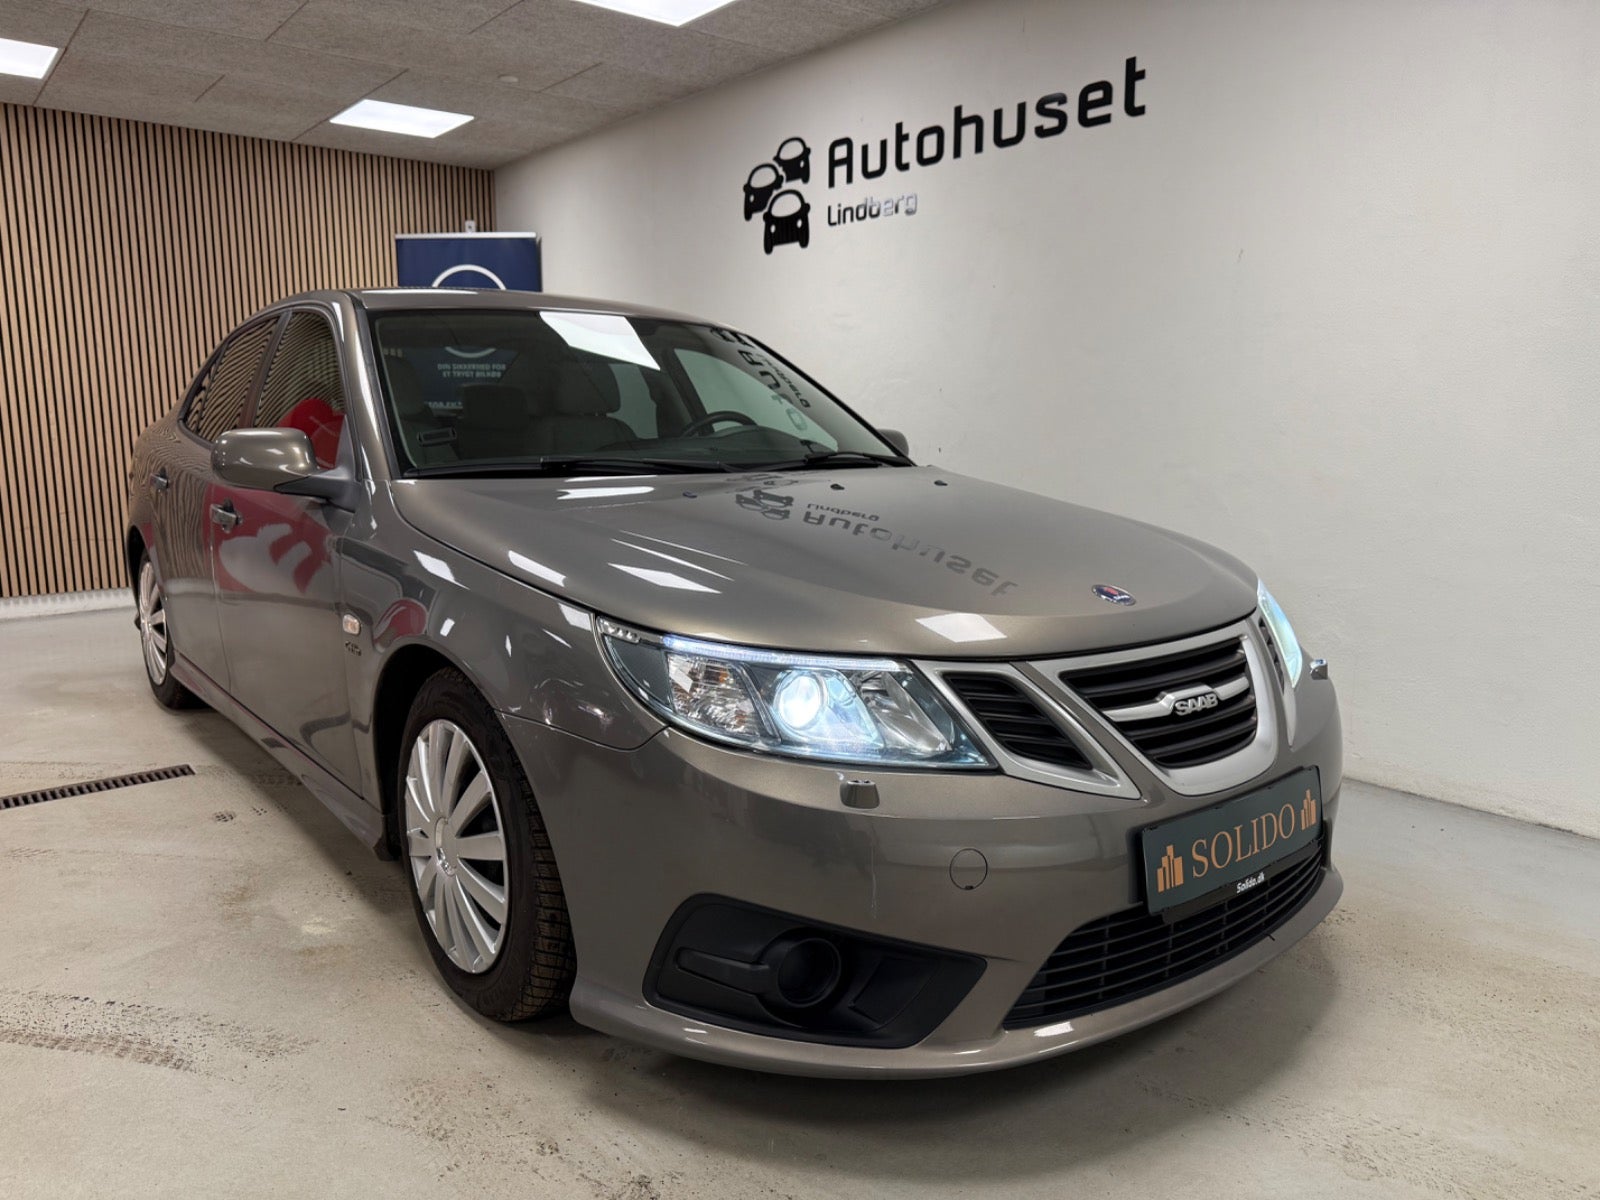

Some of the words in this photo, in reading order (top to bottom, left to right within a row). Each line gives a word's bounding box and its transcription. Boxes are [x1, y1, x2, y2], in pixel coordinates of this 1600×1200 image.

[828, 56, 1146, 188] Autohuset
[827, 193, 918, 226] Lindberg
[1175, 694, 1218, 715] SAAB
[1191, 803, 1295, 879] SOLIDO
[1236, 871, 1265, 894] Solido.dk
